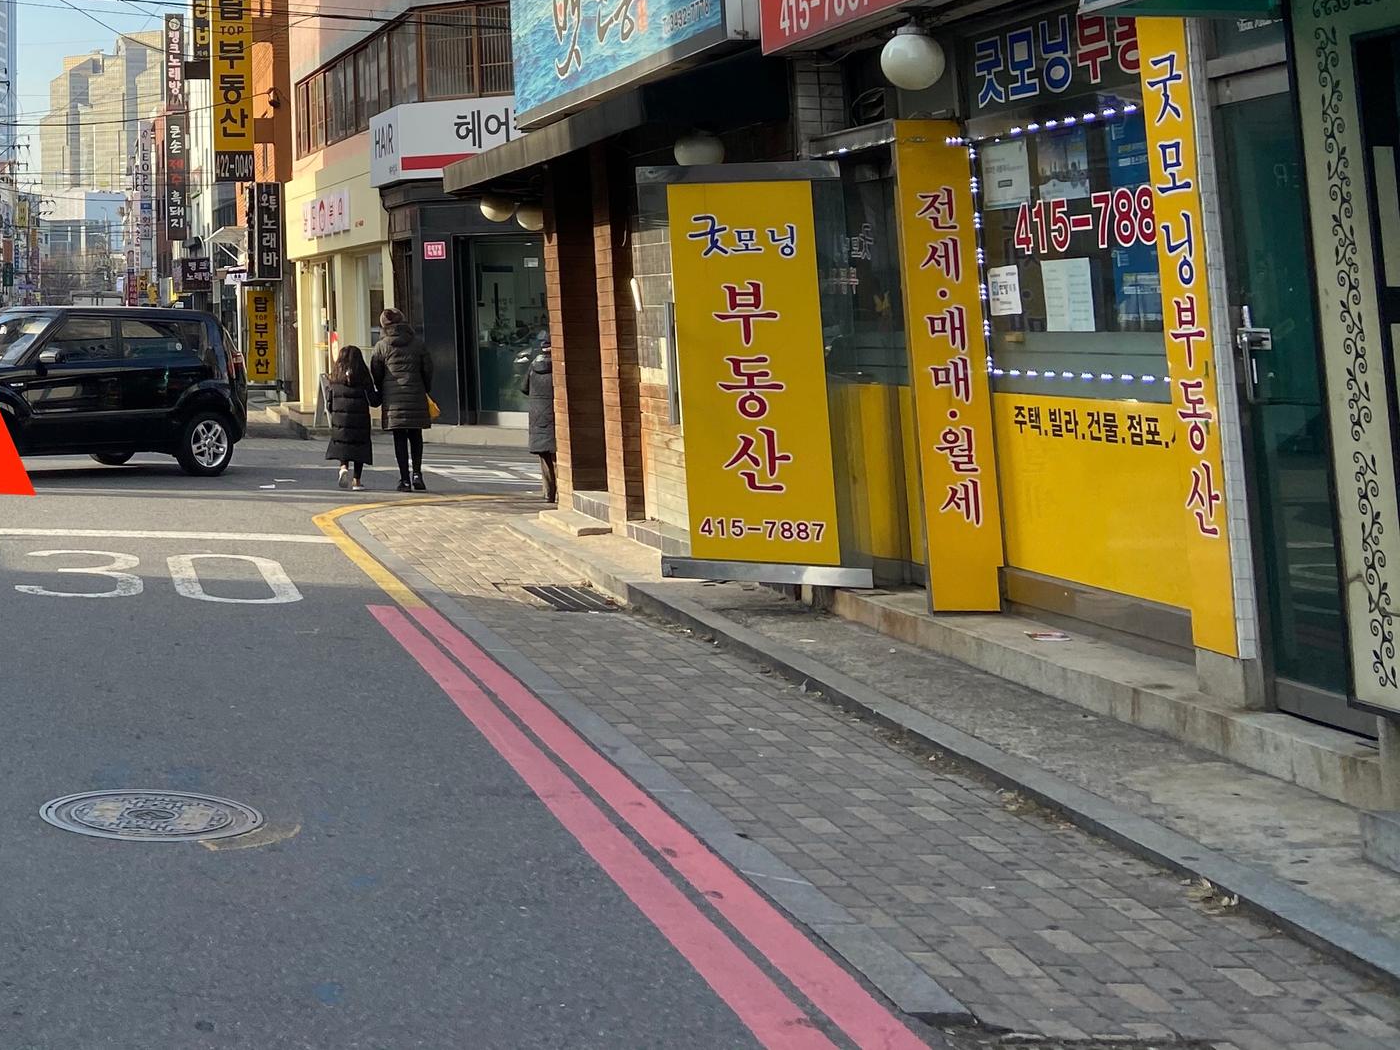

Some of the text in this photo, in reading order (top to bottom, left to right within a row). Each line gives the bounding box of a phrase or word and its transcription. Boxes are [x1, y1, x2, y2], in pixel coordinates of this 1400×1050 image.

[220, 26, 244, 35] TOP
[219, 41, 249, 138] 부동산
[374, 123, 394, 159] HAIR
[454, 108, 519, 149] 헤어
[216, 154, 254, 178] 422-0049
[688, 213, 797, 259] 굿모닝
[254, 323, 270, 375] 부동산
[713, 280, 793, 493] 부동산
[699, 517, 826, 543] 415-7887
[14, 549, 306, 606] 30
